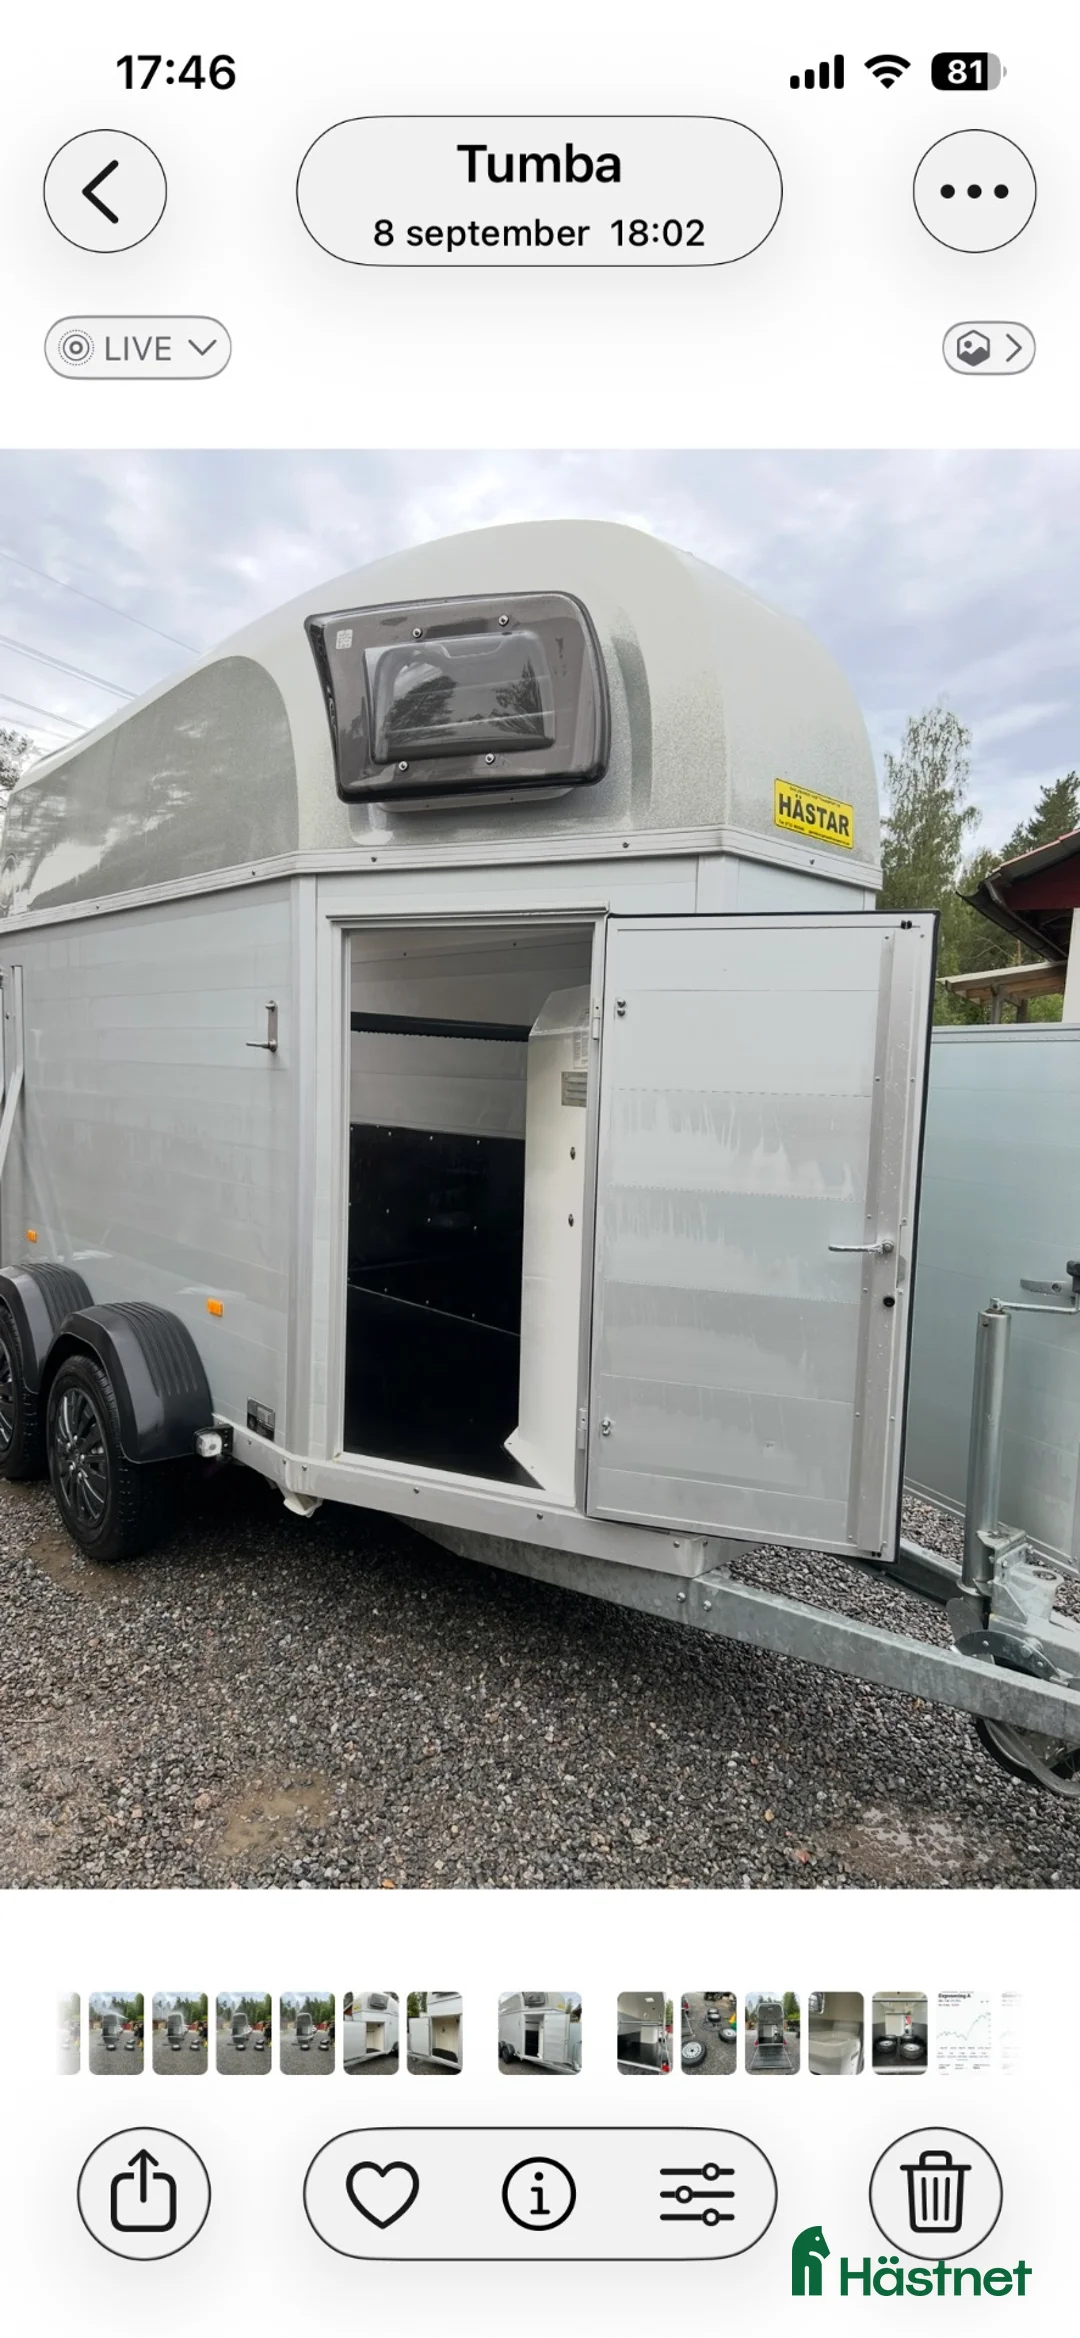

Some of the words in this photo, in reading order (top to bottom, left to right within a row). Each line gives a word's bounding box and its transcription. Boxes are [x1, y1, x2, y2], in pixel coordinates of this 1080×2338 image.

[116, 54, 236, 91] 17:46
[947, 59, 982, 84] 81
[456, 142, 621, 184] Tumba
[373, 218, 394, 247] 8
[406, 218, 591, 253] september
[610, 218, 705, 247] 18:02
[105, 336, 171, 361] LIVE
[778, 792, 850, 837] HÄSTAR
